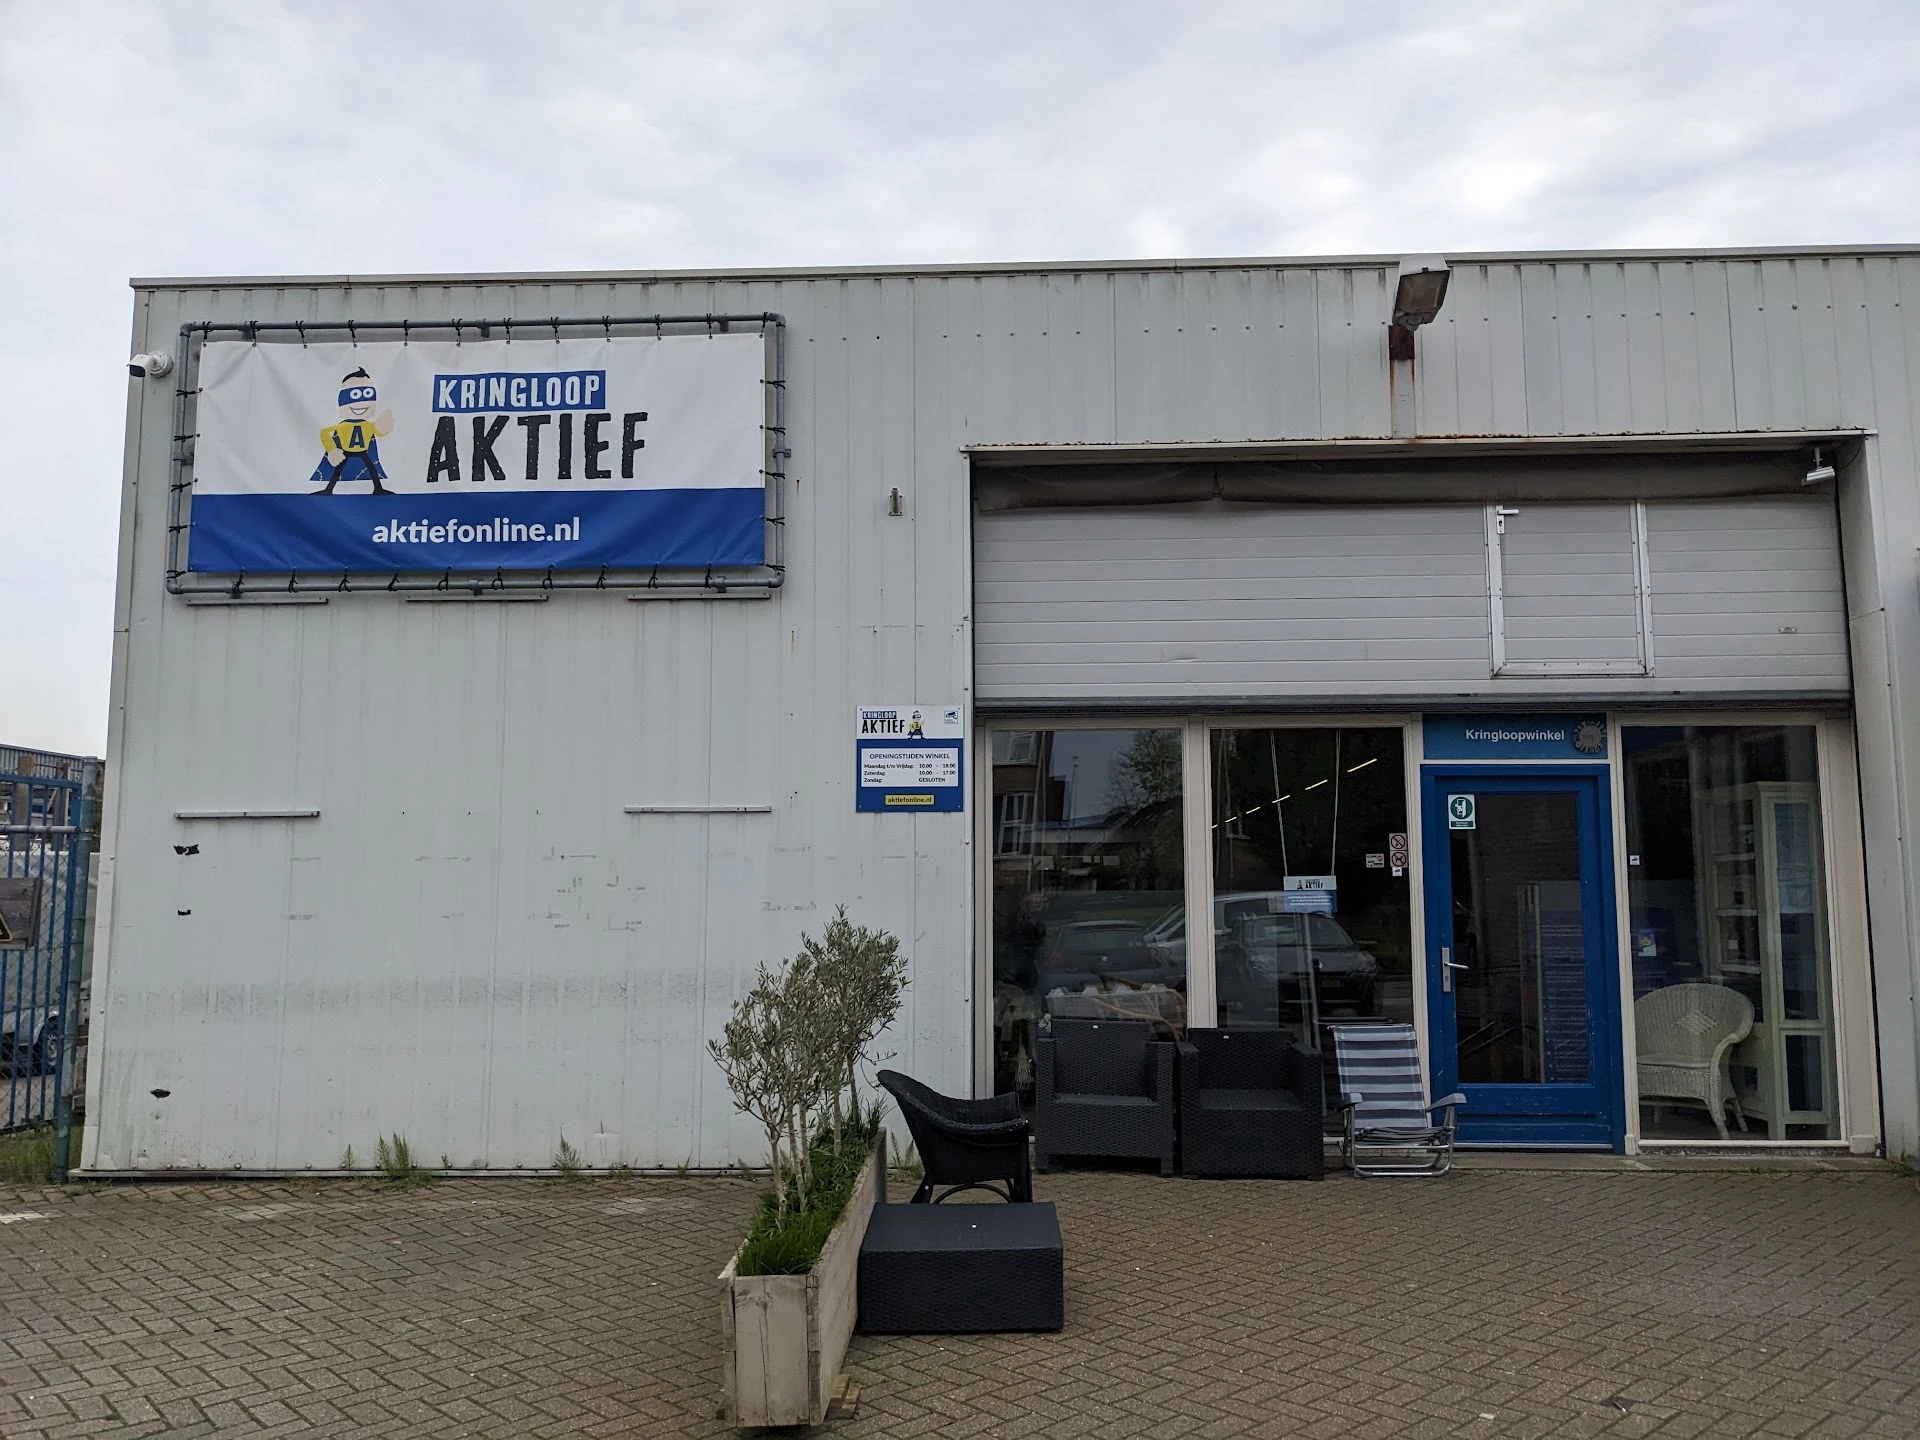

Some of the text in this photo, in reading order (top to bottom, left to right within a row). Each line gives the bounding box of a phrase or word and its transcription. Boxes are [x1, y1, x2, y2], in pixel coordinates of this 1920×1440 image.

[438, 375, 600, 409] KRINGLOOP
[348, 425, 366, 449] A
[427, 412, 648, 483] AKTIEF
[372, 516, 581, 544] aktiefonline.nl
[861, 720, 905, 733] AKTIEF
[863, 711, 896, 719] KRINGLOOP
[1465, 729, 1565, 742] Kringloopwinkel
